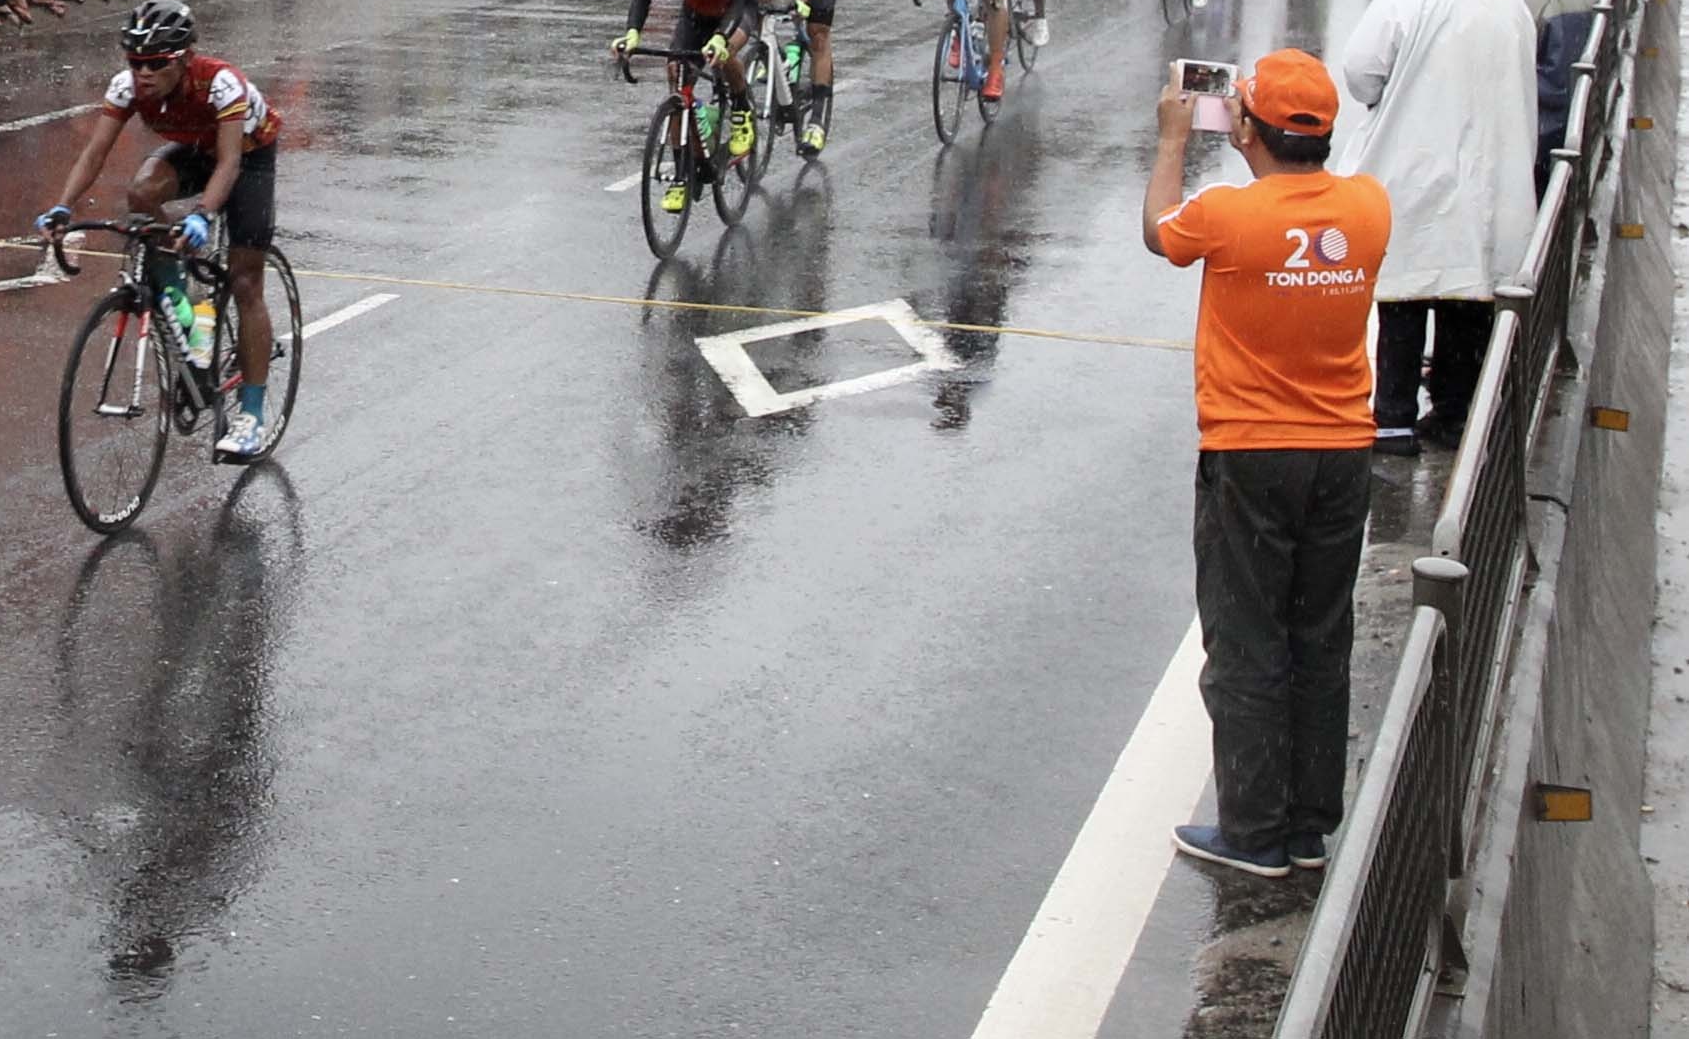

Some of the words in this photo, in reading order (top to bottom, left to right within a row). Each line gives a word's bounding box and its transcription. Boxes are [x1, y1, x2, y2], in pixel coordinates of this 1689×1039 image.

[1264, 271, 1305, 287] TON
[1306, 269, 1353, 287] DONG
[1354, 267, 1366, 283] A
